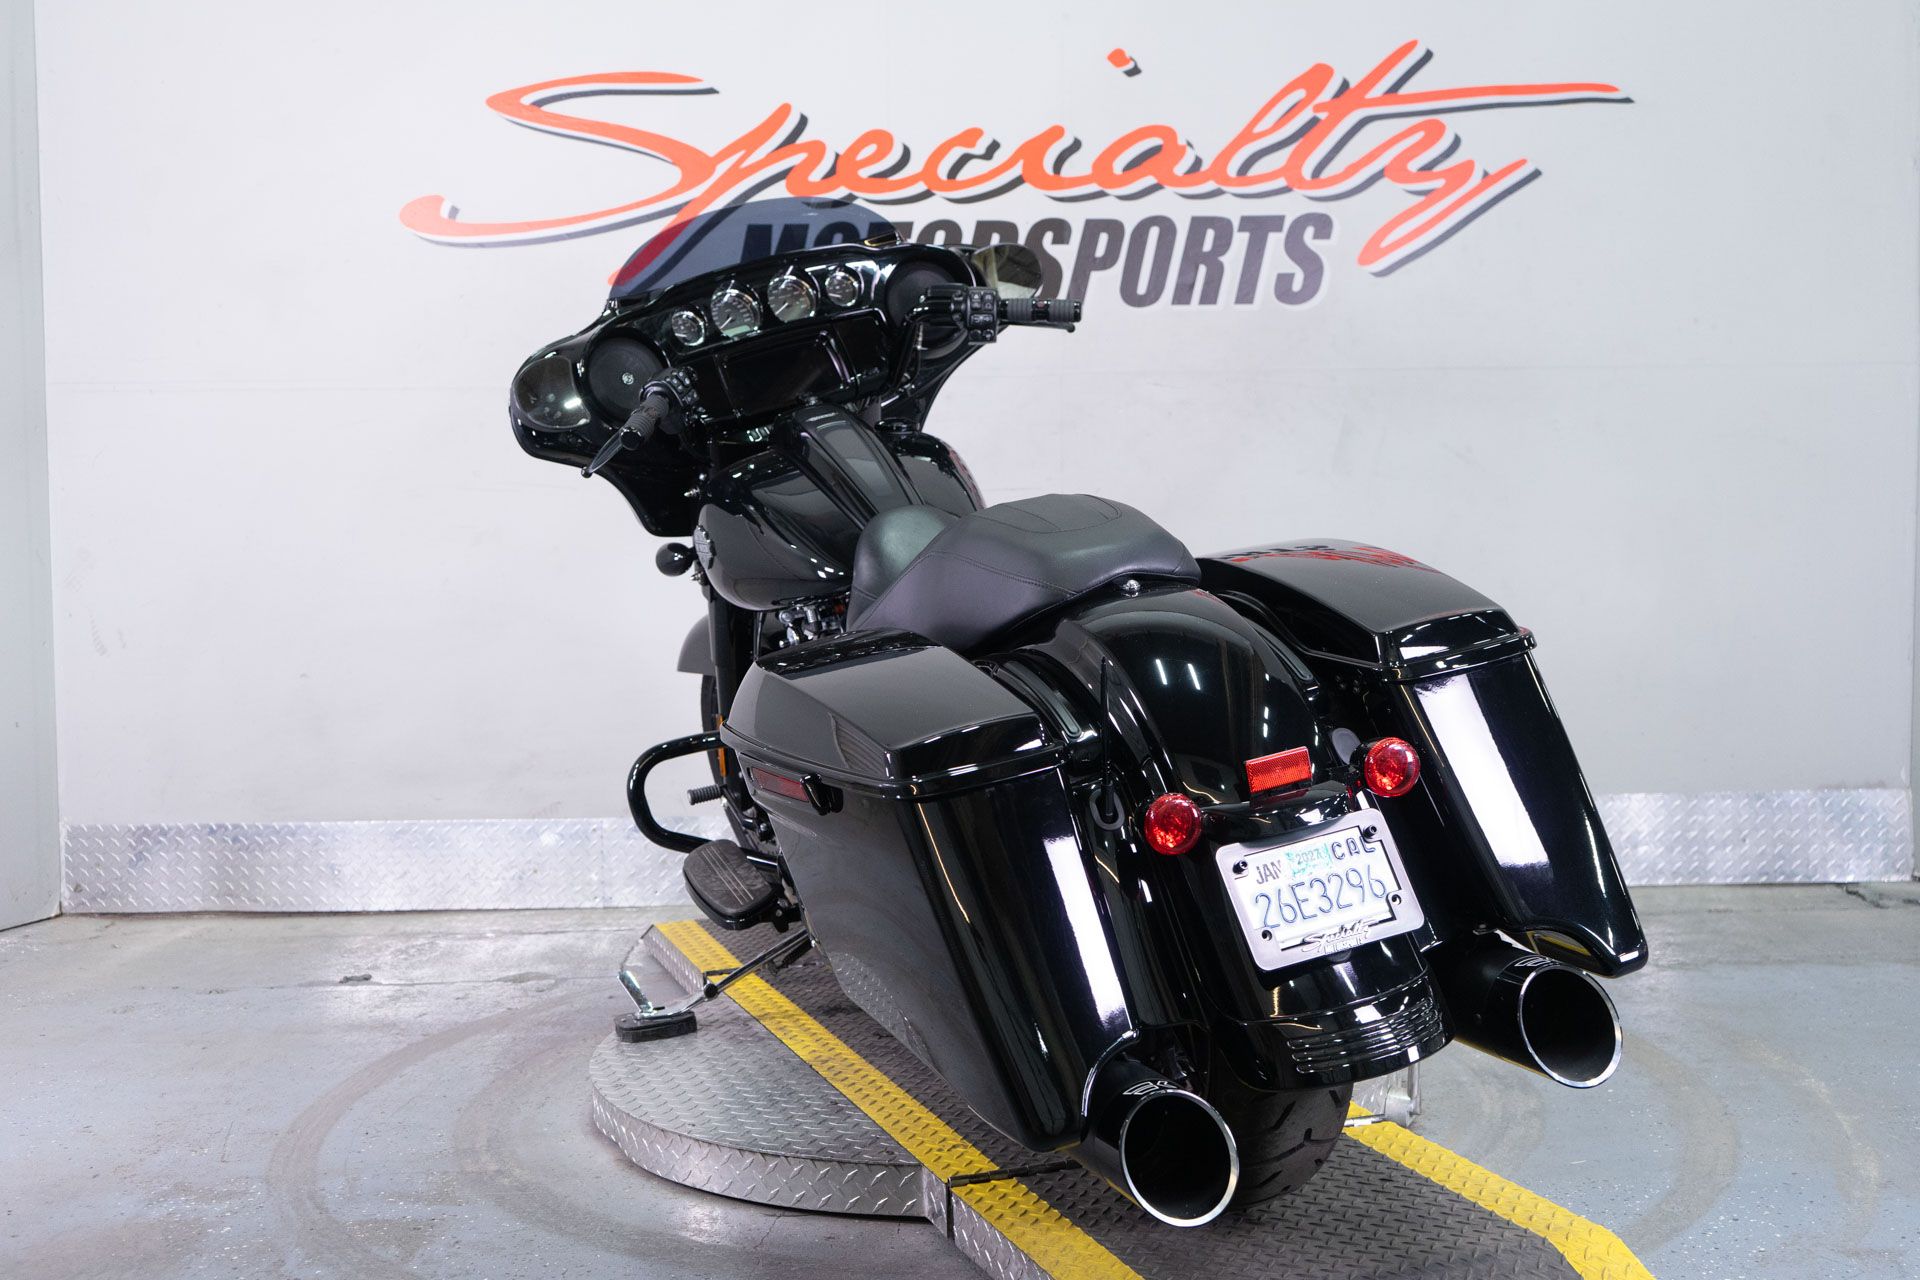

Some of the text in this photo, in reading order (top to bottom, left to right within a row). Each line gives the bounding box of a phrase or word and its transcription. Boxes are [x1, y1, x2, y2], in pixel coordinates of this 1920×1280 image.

[399, 39, 1634, 290] Specialty
[732, 213, 1335, 307] SPORTS
[1255, 859, 1283, 885] JAN
[1331, 835, 1376, 861] CAL
[1255, 865, 1387, 929] 26E3296
